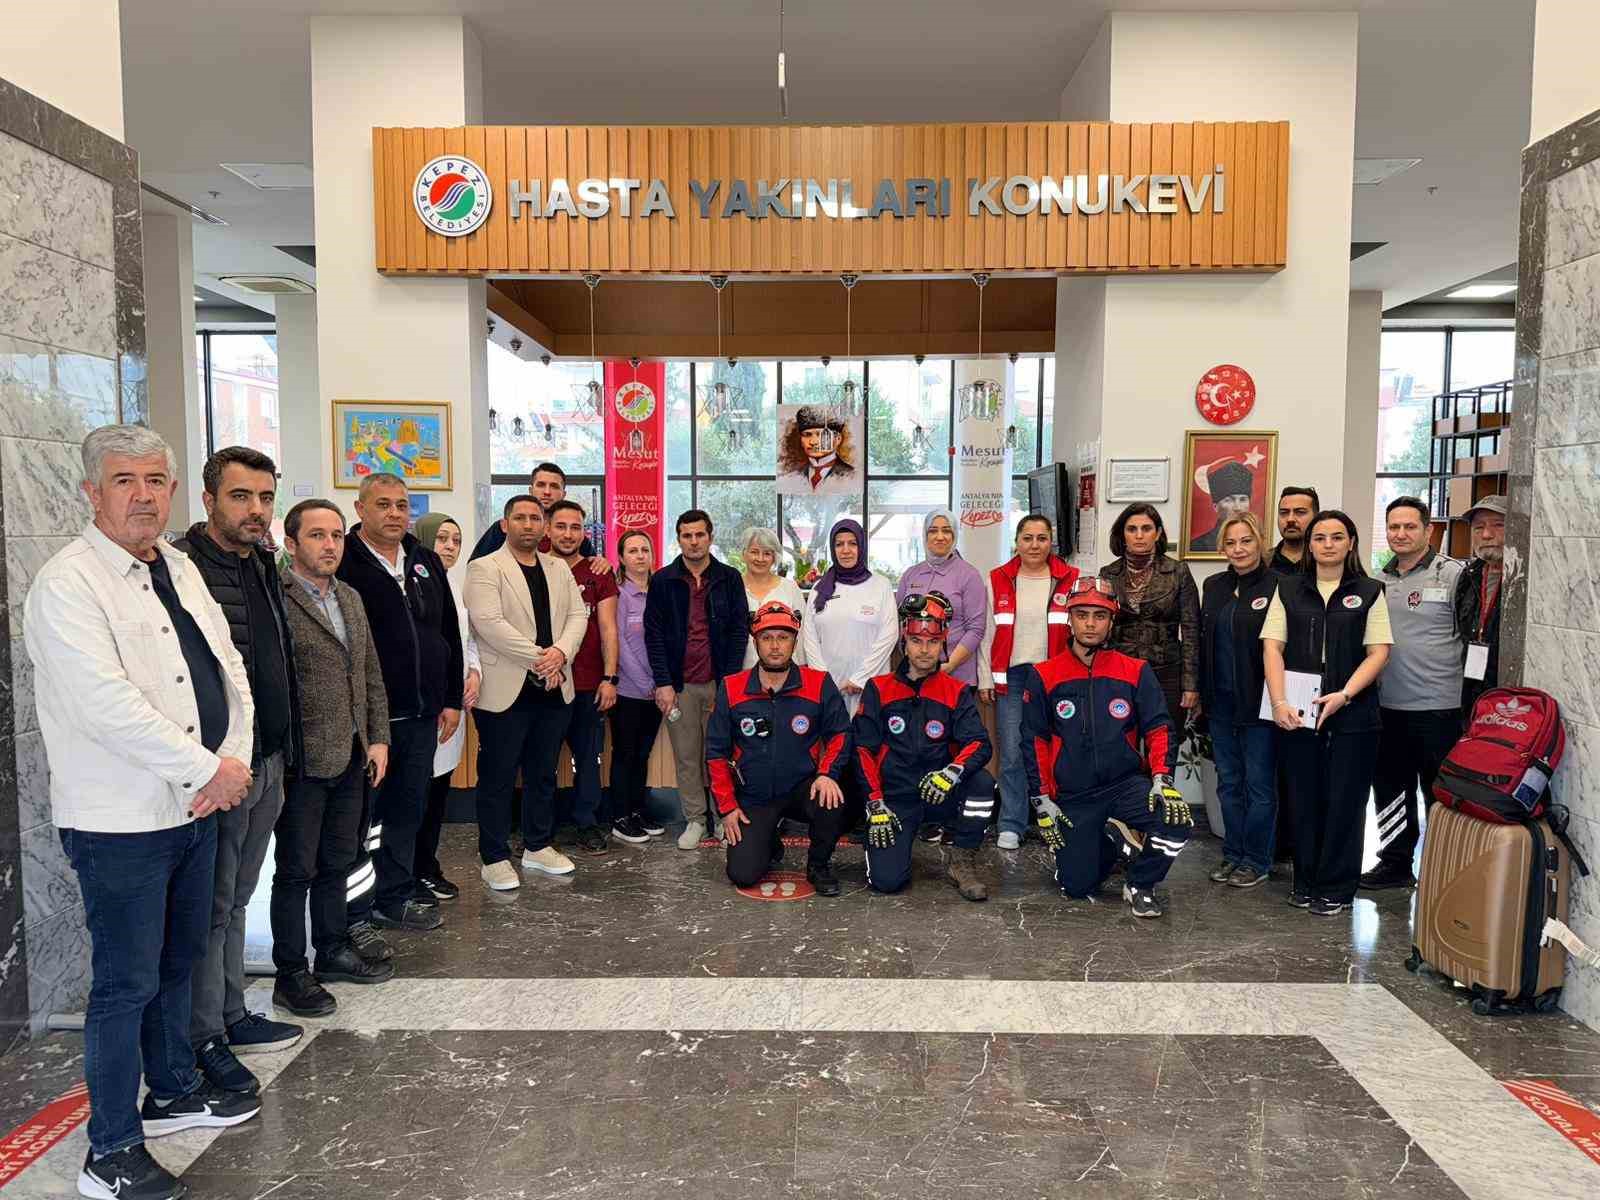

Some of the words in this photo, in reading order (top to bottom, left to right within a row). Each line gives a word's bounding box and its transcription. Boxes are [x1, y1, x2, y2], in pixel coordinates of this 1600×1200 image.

[422, 162, 480, 188] KEPEZ
[510, 178, 675, 218] HASTA
[689, 178, 950, 218] YAKINLARI
[969, 164, 1224, 215] KONUKEVİ
[960, 499, 1003, 509] GELECEĞ
